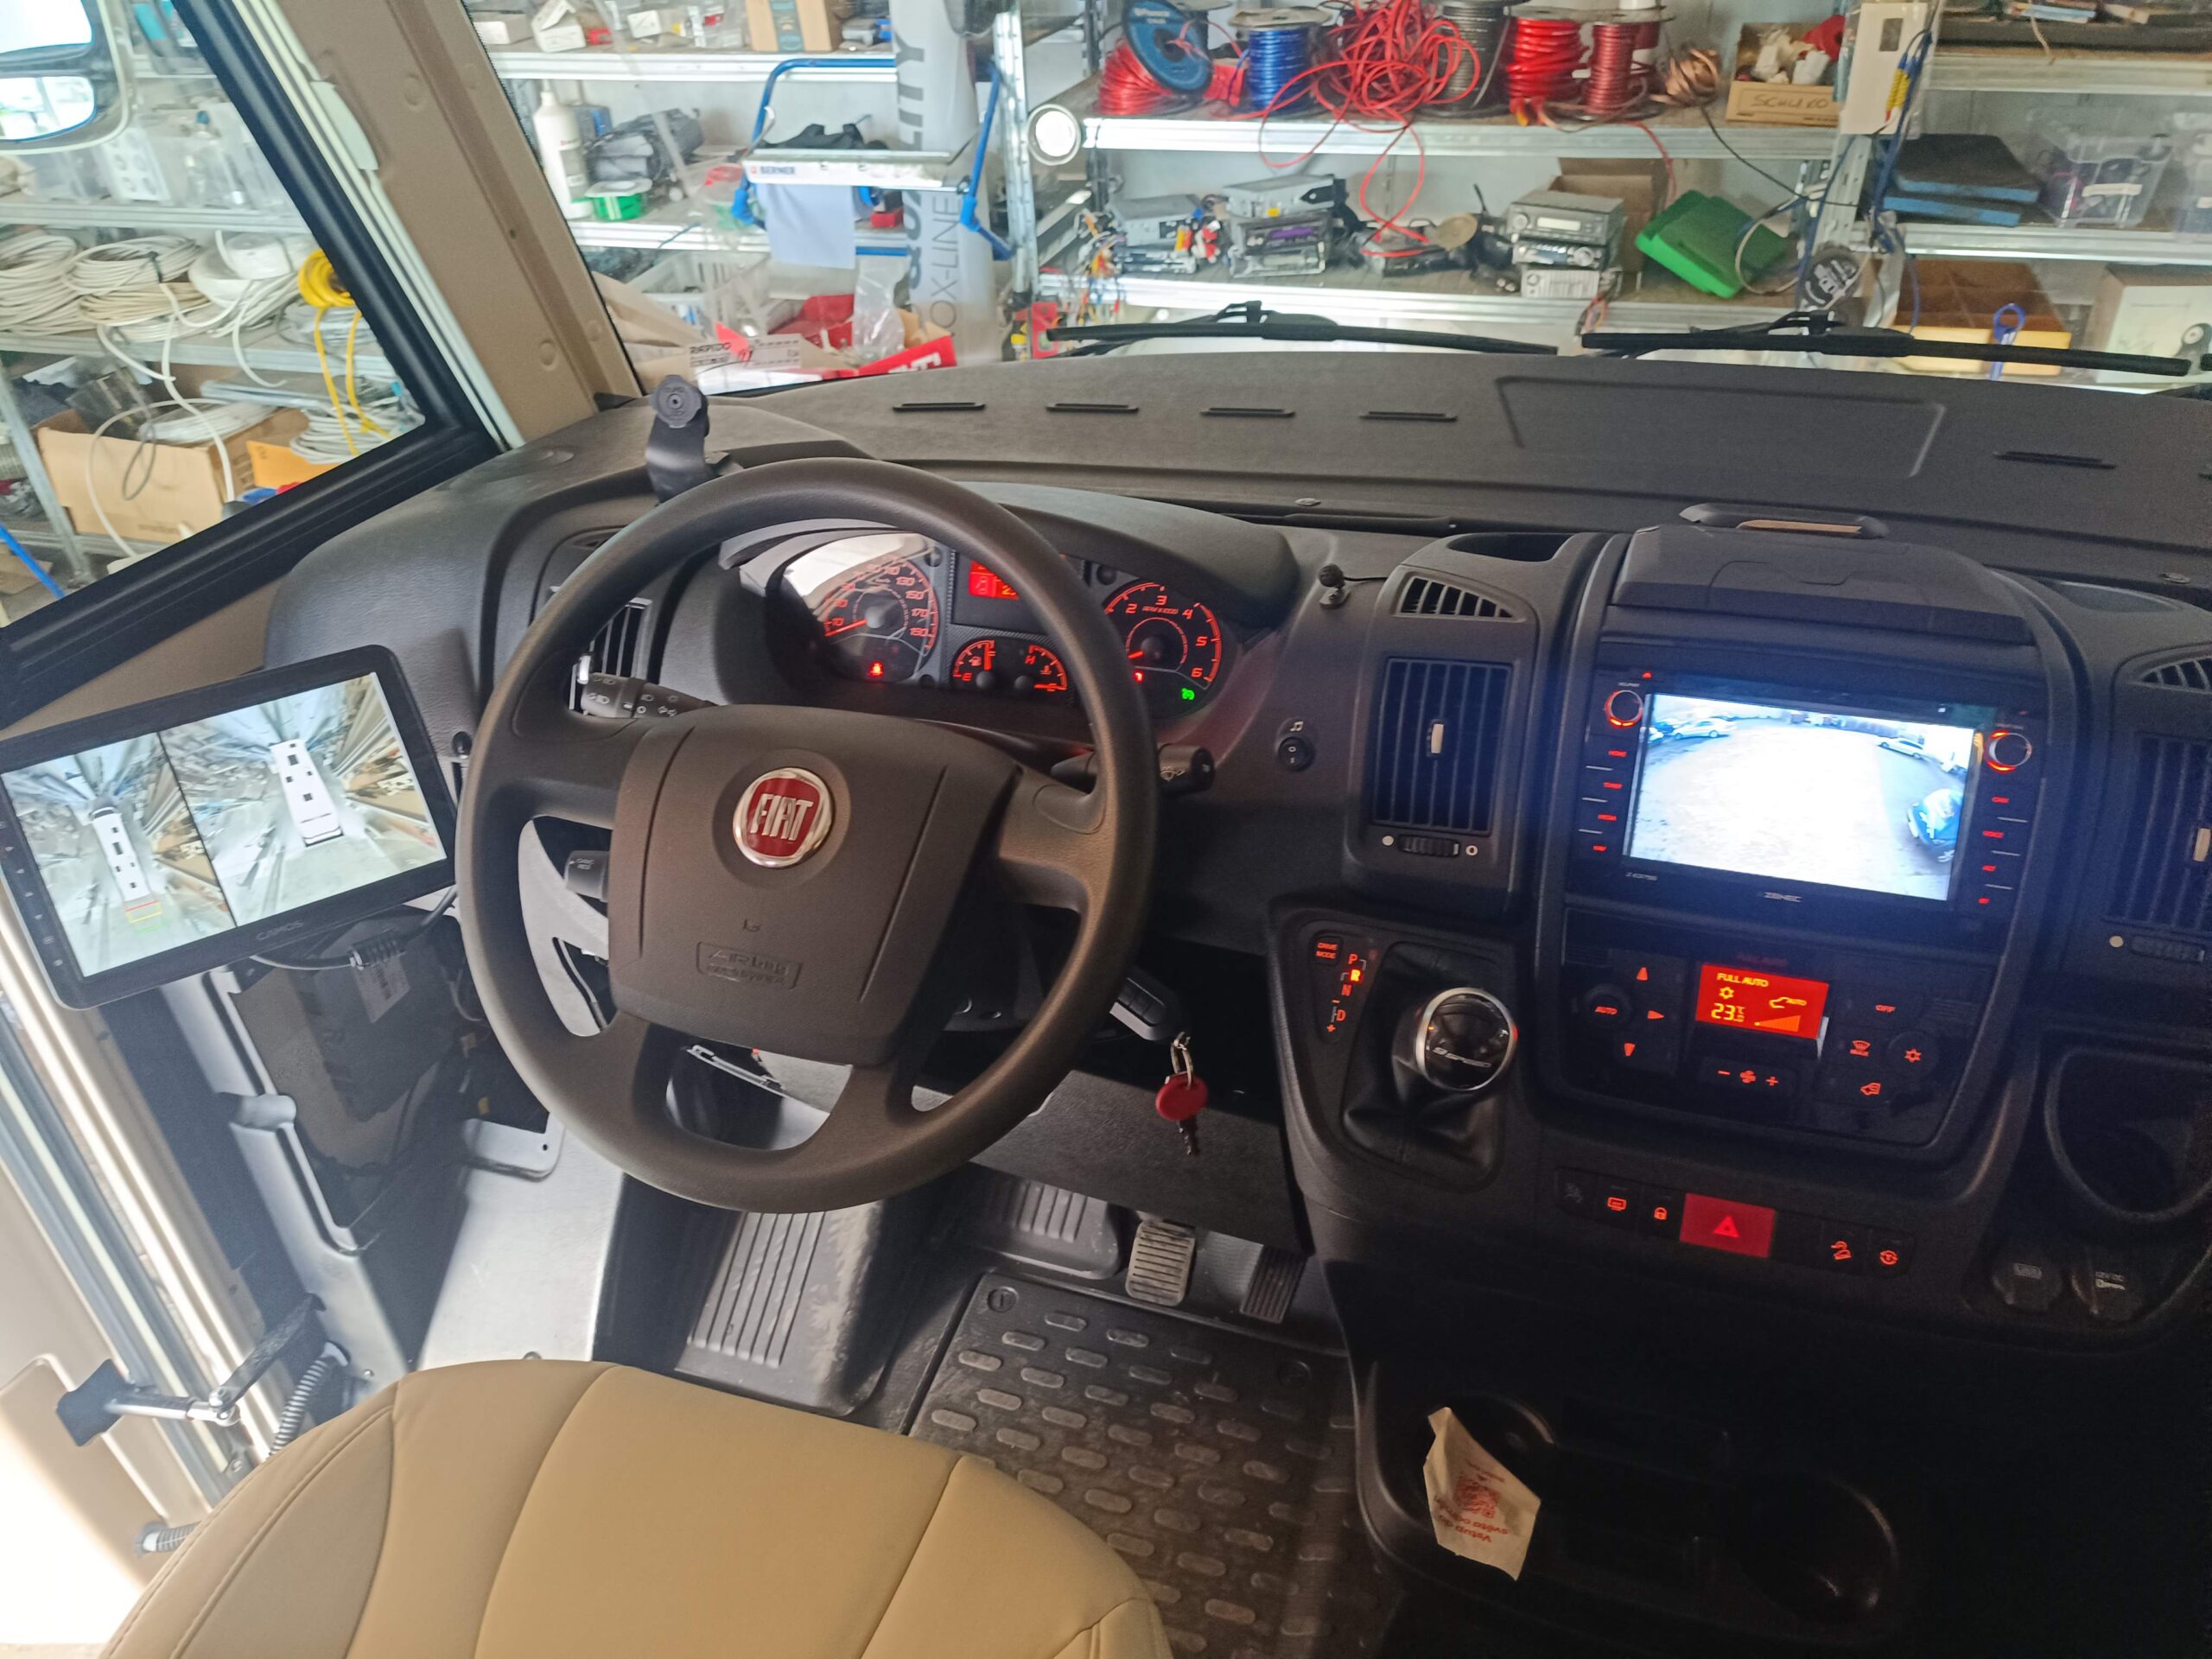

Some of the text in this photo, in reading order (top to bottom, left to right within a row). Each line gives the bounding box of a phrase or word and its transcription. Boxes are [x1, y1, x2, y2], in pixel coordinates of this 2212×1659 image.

[895, 33, 925, 290] QULITY
[928, 194, 960, 339] OX-LINE
[1155, 595, 1167, 606] 3
[1126, 603, 1138, 614] 2
[1182, 609, 1193, 620] 4
[1196, 636, 1208, 646] 5
[1025, 655, 1036, 664] H
[962, 672, 973, 682] E
[1192, 667, 1203, 677] 6
[749, 793, 814, 842] FIAT
[1348, 953, 1358, 964] P
[1351, 969, 1361, 982] R
[1716, 972, 1769, 988] FULL AUTO
[1341, 984, 1352, 996] N
[1785, 997, 1807, 1007] AUTO
[1875, 1004, 1896, 1013] OFF
[1336, 1009, 1346, 1021] D
[1472, 1522, 1508, 1535] světa
[1455, 1526, 1492, 1544] Vstup
